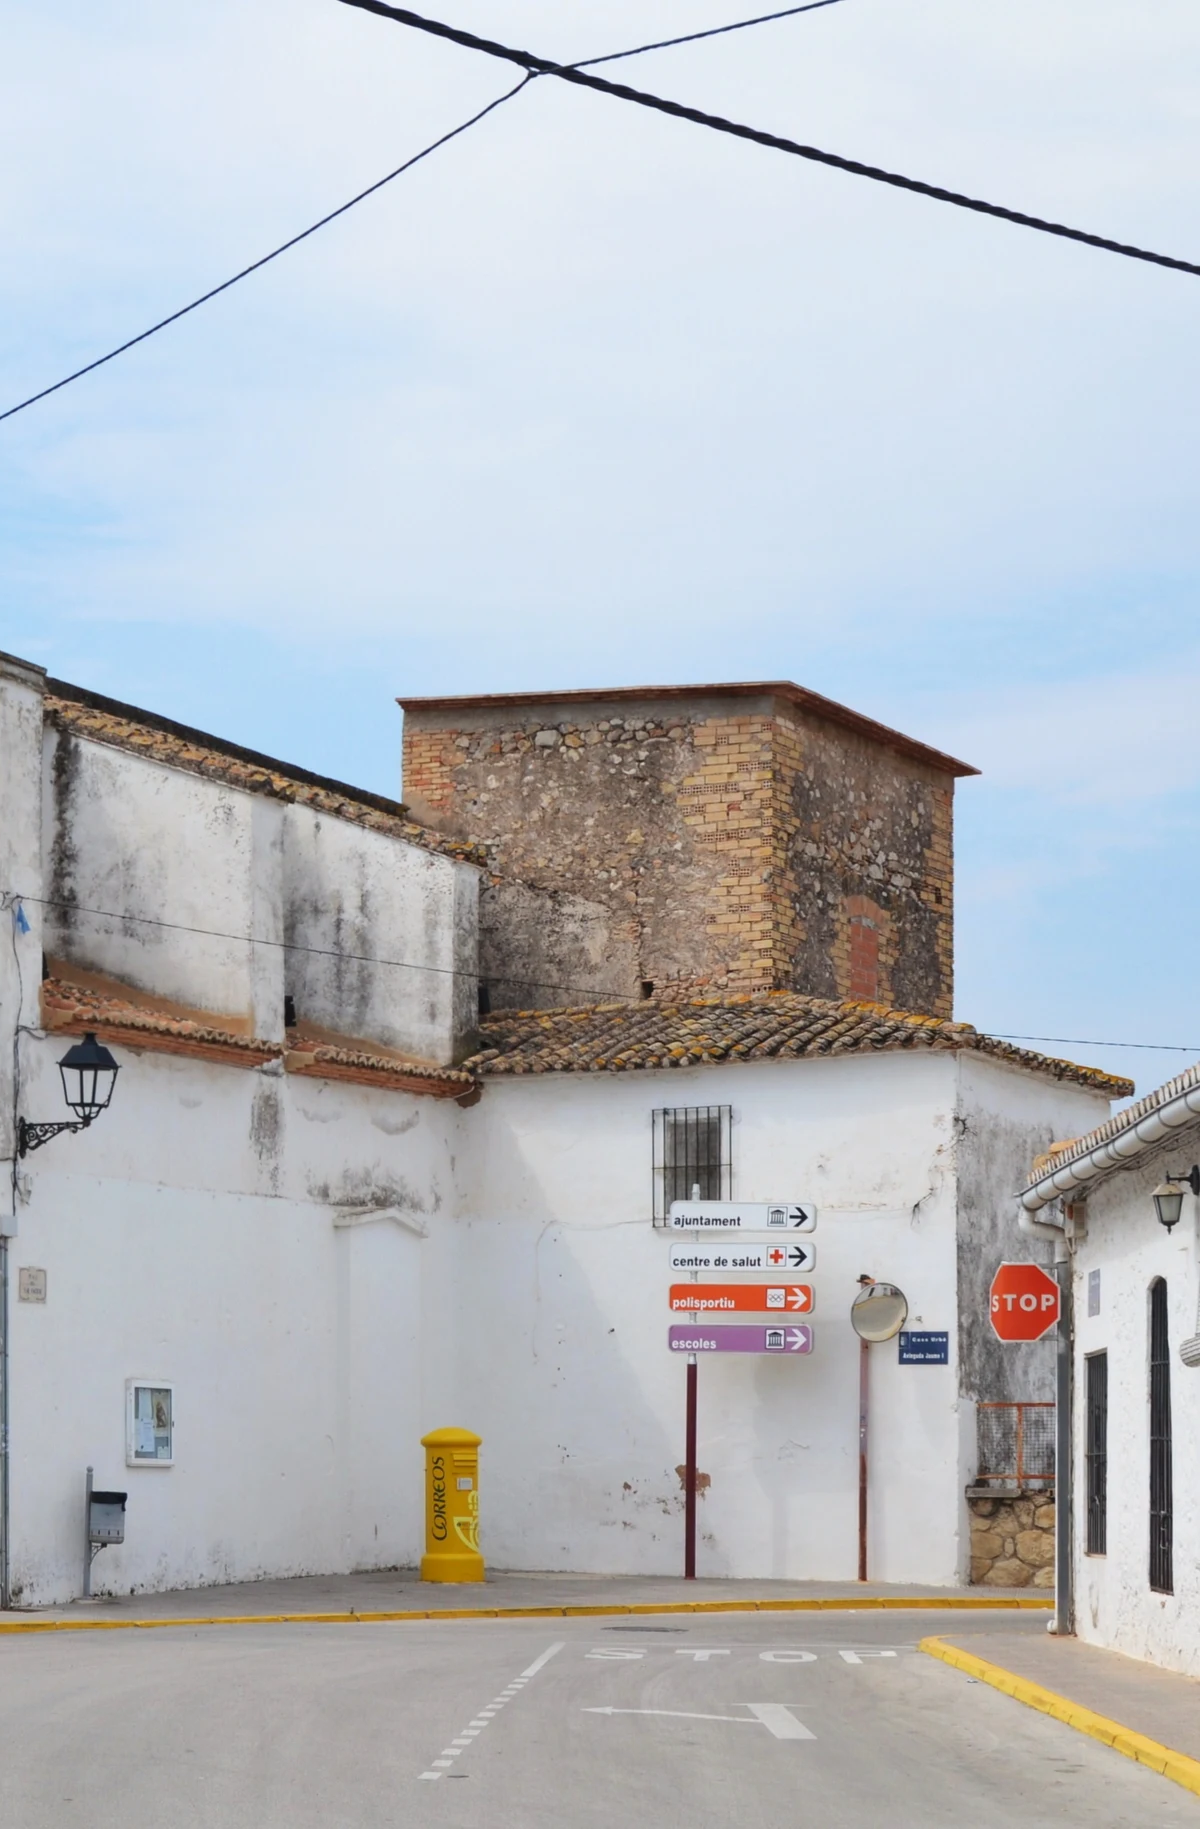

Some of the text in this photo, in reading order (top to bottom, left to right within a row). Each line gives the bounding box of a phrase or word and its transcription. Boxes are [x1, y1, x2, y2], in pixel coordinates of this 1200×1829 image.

[673, 1215, 742, 1229] ajuntament
[672, 1255, 762, 1268] centre de salut
[672, 1297, 736, 1311] polisportiu
[991, 1293, 1056, 1313] STOP
[671, 1337, 717, 1350] escoles
[902, 1352, 924, 1360] Avinguda
[431, 1455, 448, 1541] CORREOS
[584, 1647, 898, 1664] STOP
